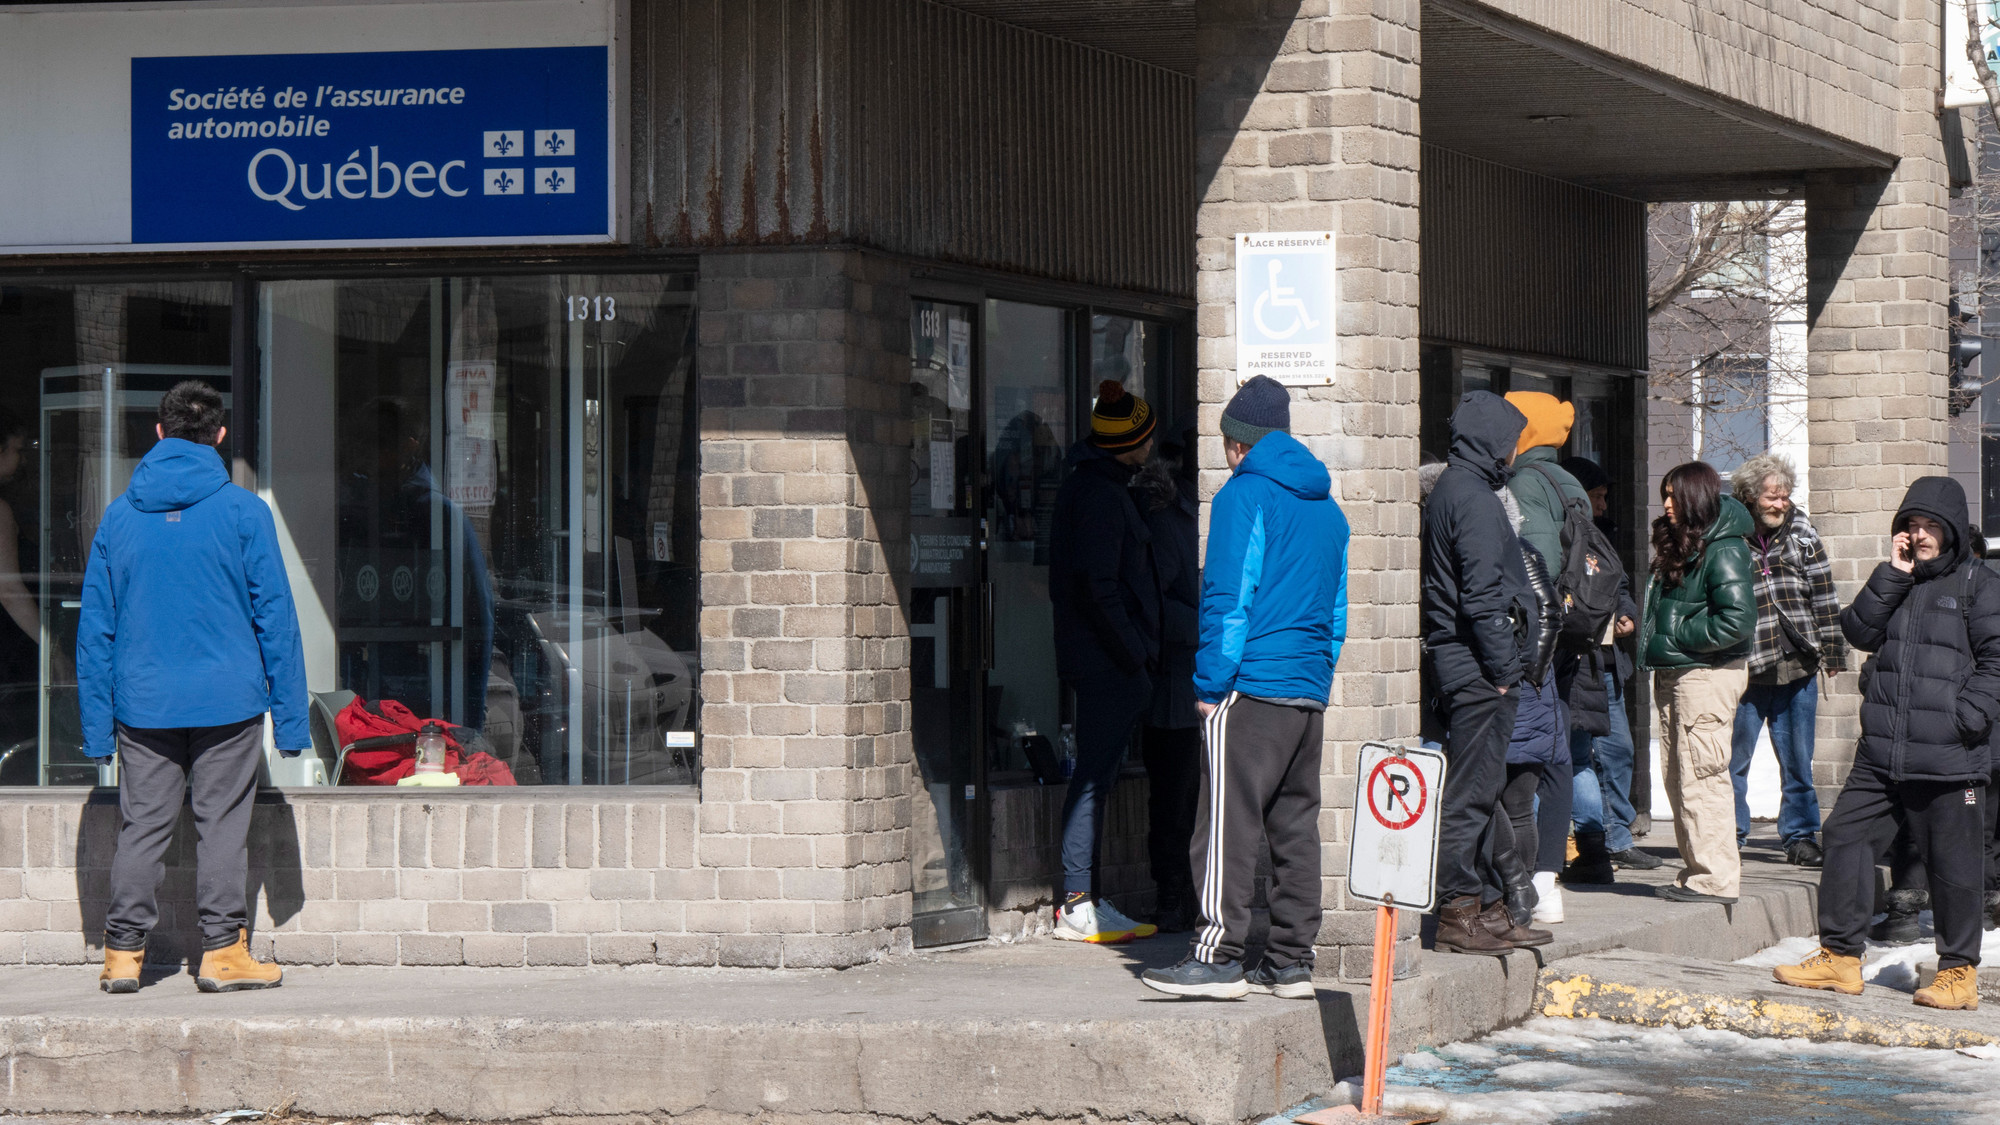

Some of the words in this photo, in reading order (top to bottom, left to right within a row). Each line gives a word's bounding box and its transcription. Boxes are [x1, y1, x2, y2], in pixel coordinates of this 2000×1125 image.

[168, 86, 265, 110] Société
[273, 87, 307, 108] de
[315, 86, 465, 107] l'assurance
[168, 115, 330, 139] automobile
[247, 145, 469, 211] Québec
[1243, 240, 1275, 248] PLACE
[567, 295, 616, 321] 1313
[921, 309, 940, 338] 1313
[1260, 351, 1312, 359] RESERVED
[920, 535, 938, 546] PERMIS
[939, 535, 946, 546] DE
[946, 535, 972, 546] CONDUIRE
[920, 548, 964, 560] IMMATRICULATION
[920, 562, 951, 573] MANDATAIRE
[1387, 774, 1410, 811] P
